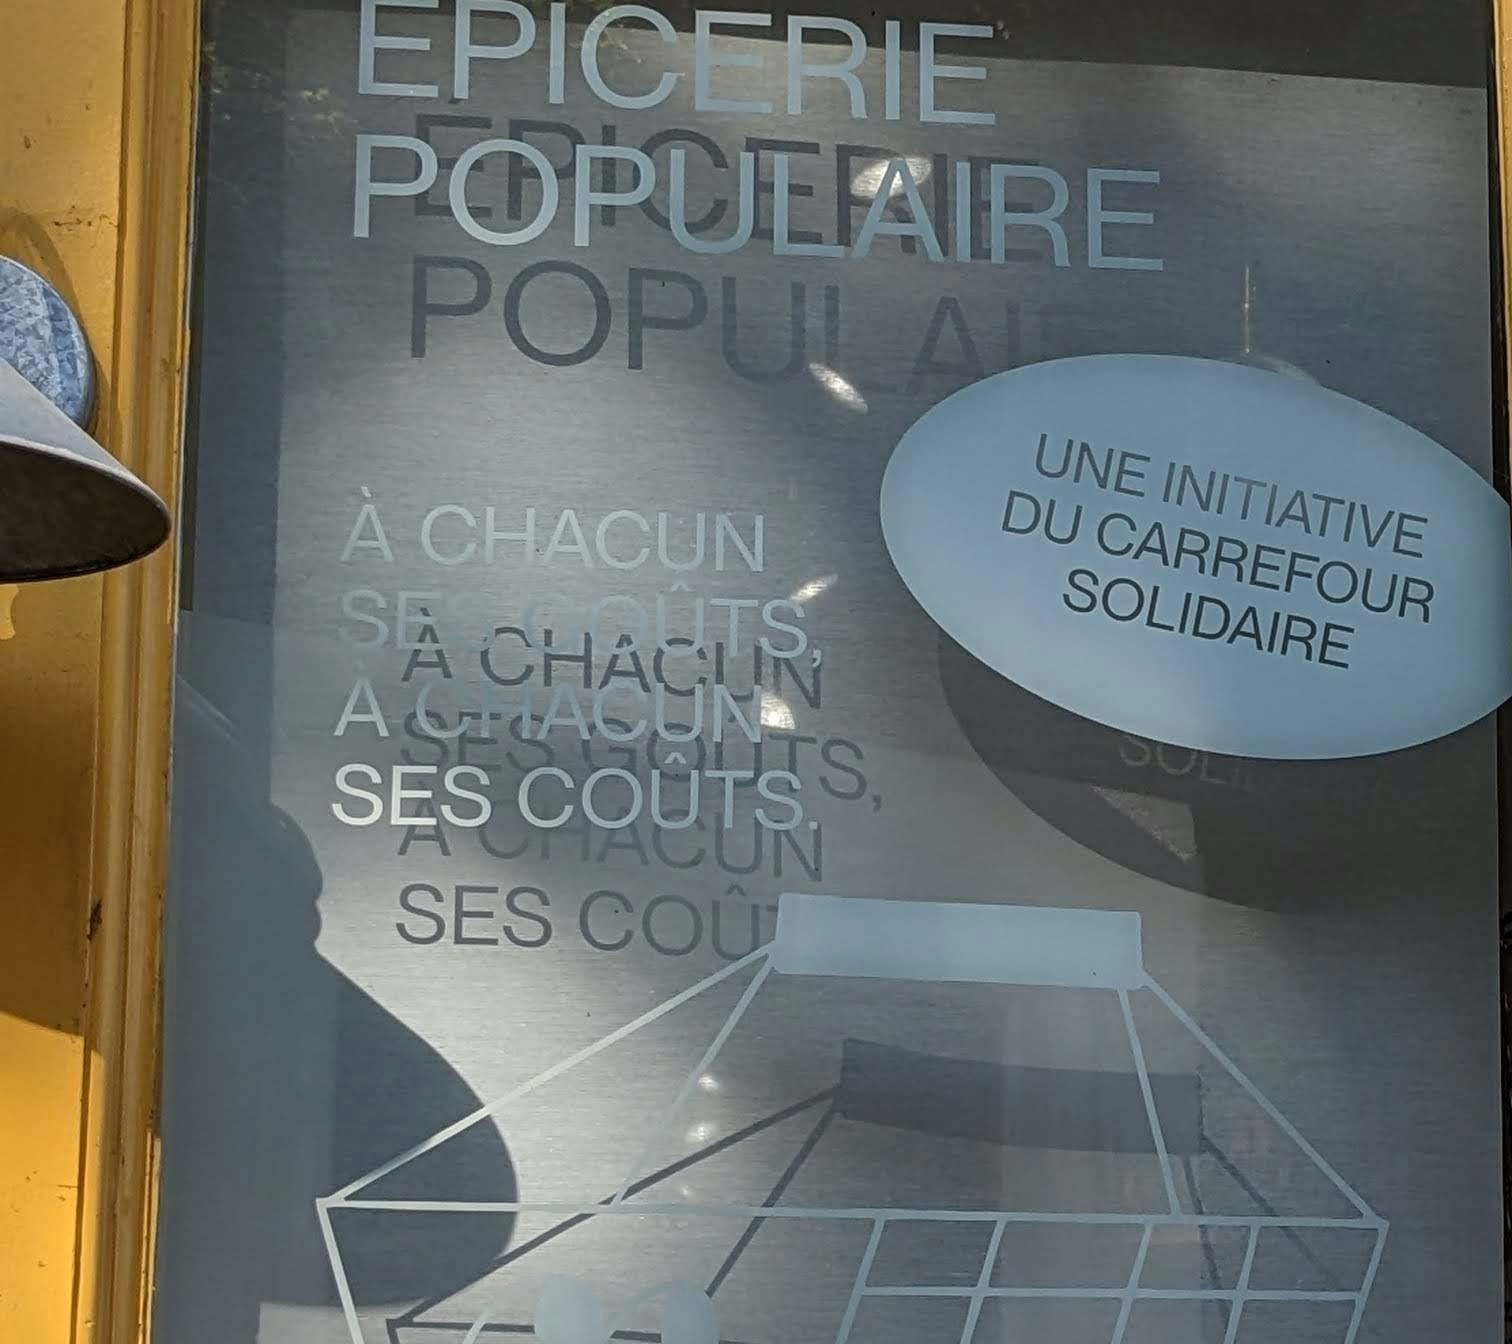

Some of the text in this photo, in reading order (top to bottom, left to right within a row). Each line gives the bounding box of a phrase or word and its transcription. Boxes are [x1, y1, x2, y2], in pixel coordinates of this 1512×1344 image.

[353, 133, 1164, 272] POPULAIRE
[339, 486, 765, 573] À CHACUN
[1035, 433, 1429, 559] UNE INITIATIVE
[1001, 490, 1435, 623] DU CARREFOUR
[1062, 568, 1355, 670] SOLIDAIRE
[413, 678, 763, 744] CHACUN
[331, 763, 492, 827] SES
